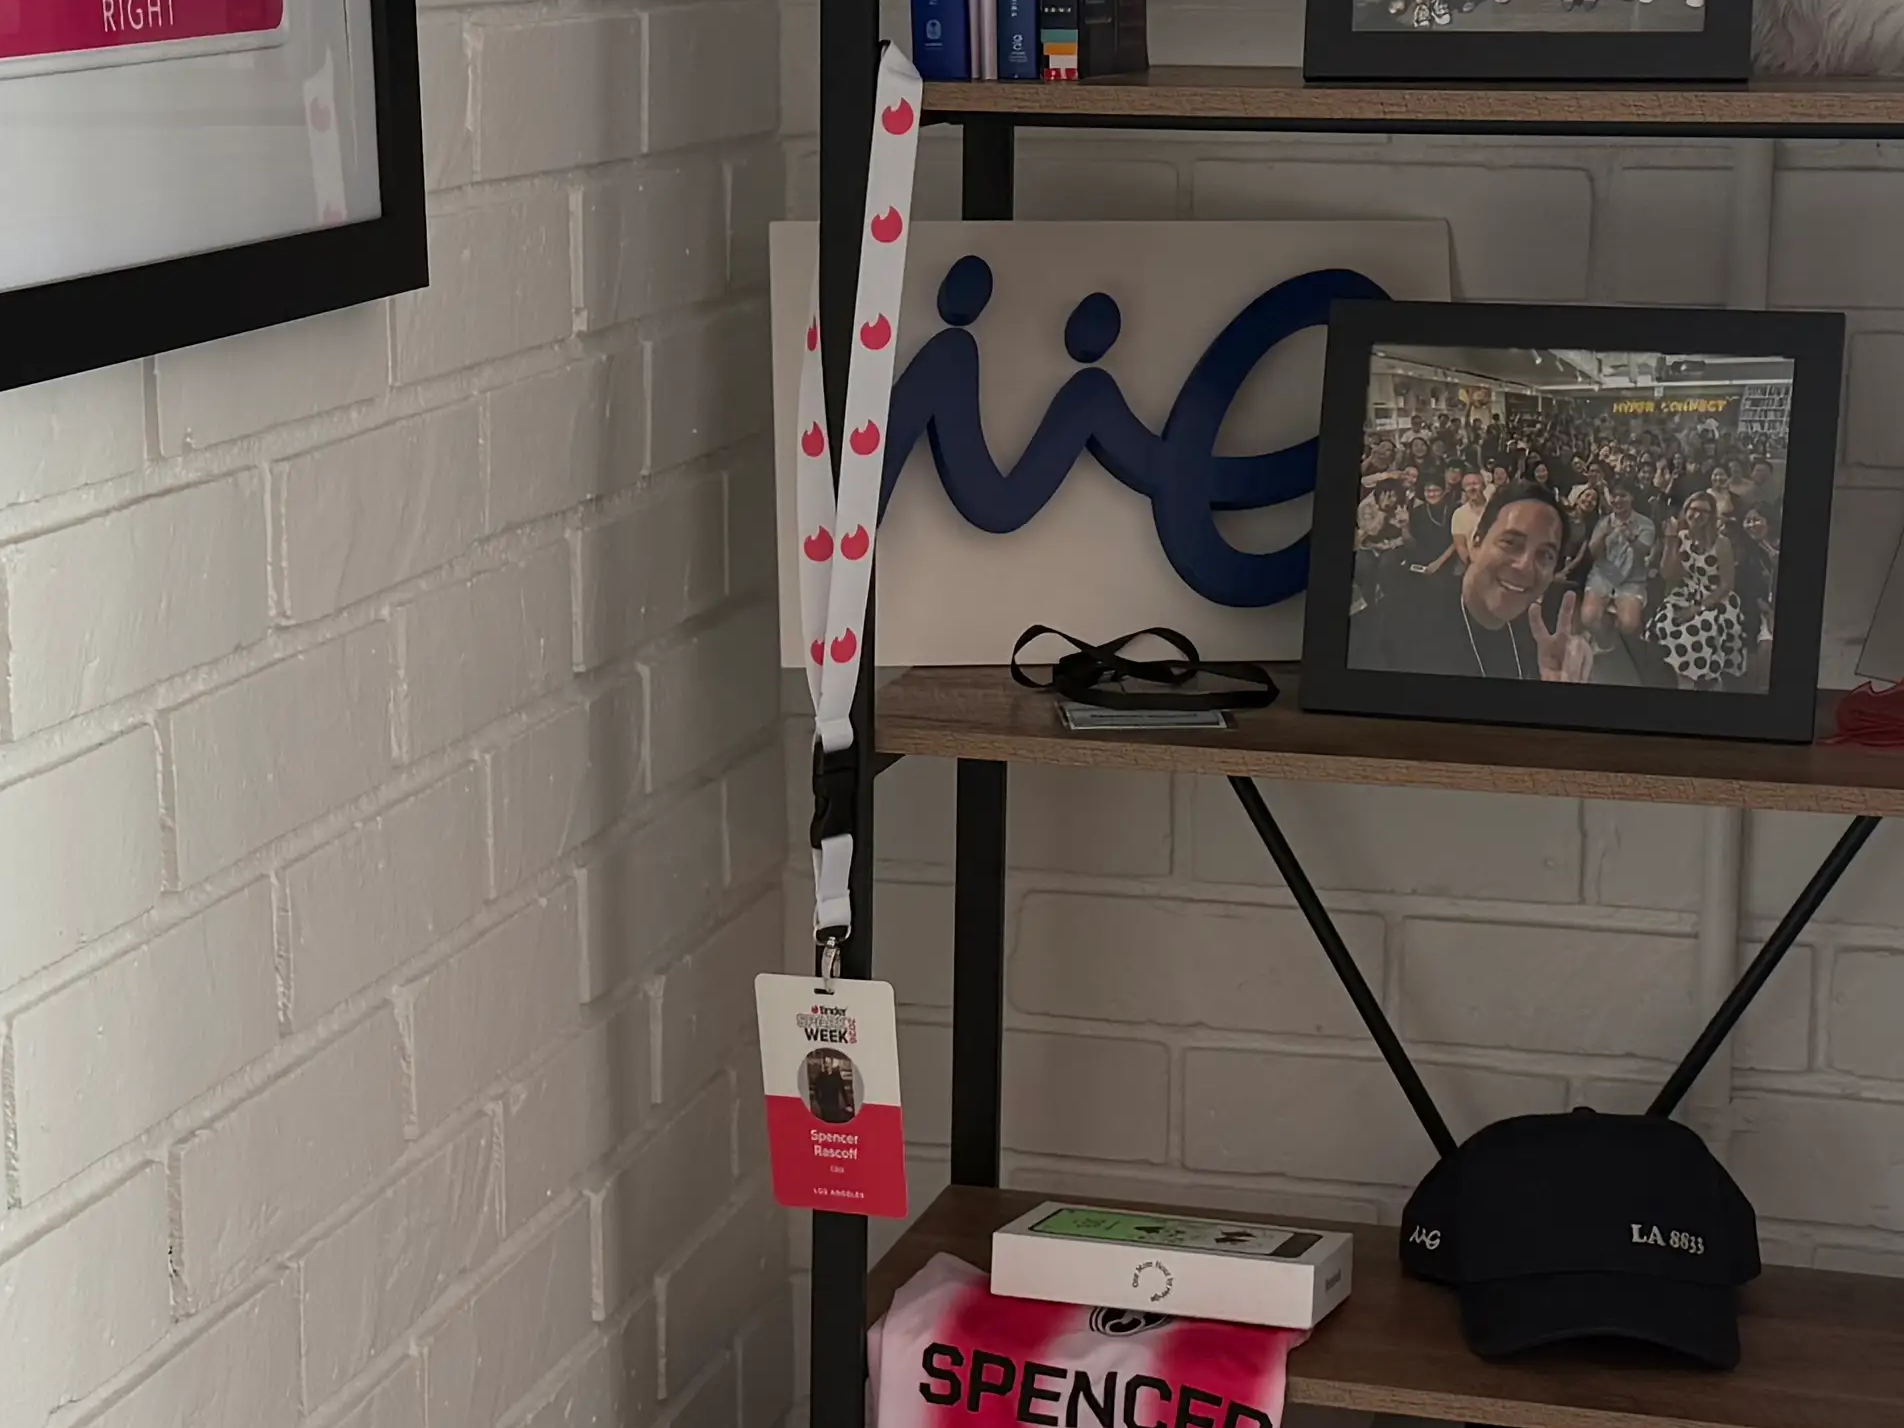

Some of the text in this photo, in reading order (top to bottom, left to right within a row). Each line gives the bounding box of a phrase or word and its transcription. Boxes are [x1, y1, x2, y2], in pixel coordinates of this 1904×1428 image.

[804, 1027, 849, 1044] WEEK
[810, 1129, 859, 1145] Spencer
[813, 1144, 858, 1160] Rascoff
[1630, 1223, 1705, 1255] LA 8833
